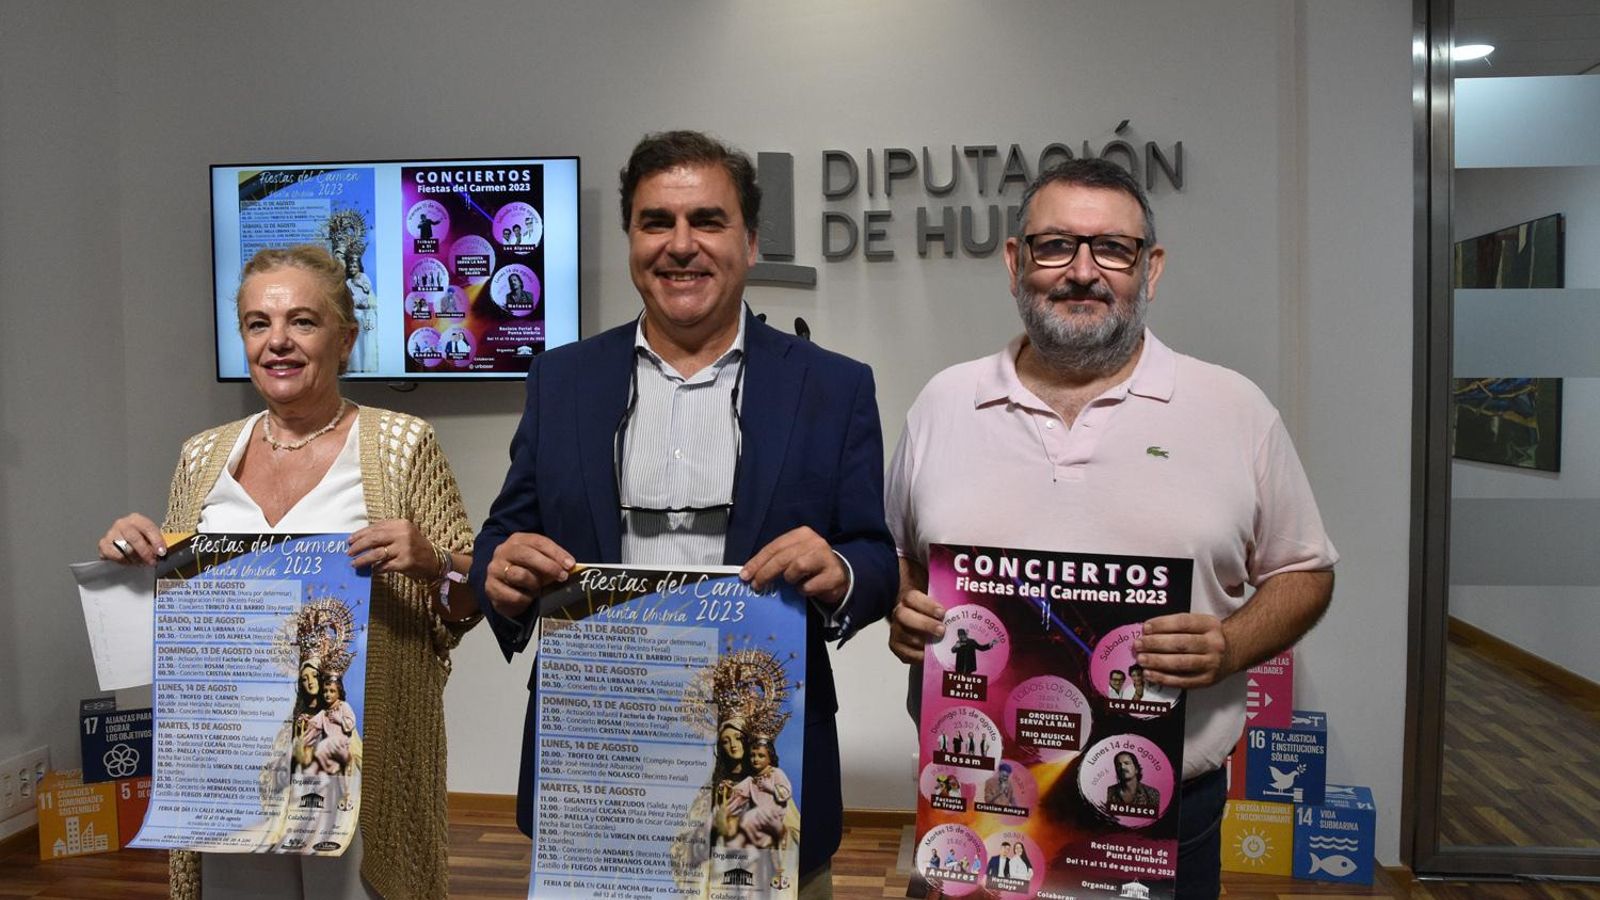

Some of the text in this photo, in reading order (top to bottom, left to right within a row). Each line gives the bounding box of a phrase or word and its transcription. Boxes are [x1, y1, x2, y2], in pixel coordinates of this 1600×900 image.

[260, 171, 294, 184] Fiestas
[298, 170, 314, 185] del
[416, 170, 531, 183] CONCIERTOS
[318, 183, 344, 195] 2023
[418, 185, 450, 193] Fiestas
[470, 184, 506, 192] Carmen
[508, 183, 531, 192] 2023
[822, 210, 895, 261] DE
[190, 534, 349, 556] Fiestas del Carmen
[204, 556, 322, 578] Punta Umbría 2023
[953, 553, 1169, 588] CONCIERTOS
[580, 568, 648, 593] Fiestas
[656, 573, 685, 597] del
[955, 576, 1168, 605] Fiestas del Carmen 2023
[597, 599, 746, 623] Punta Umbría 2023
[584, 624, 592, 633] 11
[596, 624, 608, 634] DE
[610, 625, 648, 636] AGOSTO
[962, 610, 969, 619] 11
[972, 610, 982, 620] de
[985, 618, 1006, 644] agosto
[1131, 630, 1142, 640] 12
[158, 646, 198, 655] DOMINGO,
[542, 660, 648, 676] SÁBADO, 12 DE AGOSTO
[1279, 658, 1290, 666] LAS
[948, 673, 982, 684] Tributo
[158, 684, 184, 692] LUNES,
[950, 690, 979, 699] Barrio
[542, 697, 657, 712] DOMINGO, 13 DE AGOSTO
[1109, 701, 1168, 714] Los Alpresa
[1028, 712, 1069, 721] ORQUESTA
[84, 712, 152, 734] 17 ALIANZAS PARA
[106, 725, 130, 733] LOGRAR
[158, 722, 190, 730] MARTES,
[201, 722, 211, 730] DE
[212, 723, 242, 731] AGOSTO
[597, 719, 622, 727] ROSAM
[968, 710, 978, 719] de
[979, 717, 996, 741] agosto
[1020, 718, 1044, 726] SERVA
[1057, 720, 1075, 728] BARI
[106, 730, 152, 742] LOS OBJETIVOS
[1041, 732, 1075, 742] MUSICAL
[1250, 730, 1265, 749] 16
[1286, 734, 1316, 744] JUSTICIA
[541, 738, 639, 753] LUNES, 14 DE AGOSTO
[1033, 738, 1062, 747] SALERO
[1276, 744, 1324, 754] INSTITUCIONES
[568, 752, 641, 763] TROFEO DEL CARMEN
[944, 754, 981, 766] Rosam
[1088, 740, 1162, 772] Lunes 14 de agosto
[1271, 752, 1299, 762] SÓLIDAS
[607, 770, 640, 779] NOLASCO
[122, 783, 131, 800] 5
[540, 782, 646, 797] MARTES, 15 DE AGOSTO
[38, 792, 52, 810] 11
[941, 802, 964, 811] Trapos
[976, 804, 1026, 816] Cristian Amaya
[1110, 804, 1155, 816] Nolasco
[1297, 807, 1336, 826] 14 VIDA
[1320, 820, 1359, 832] SUBMARINA
[925, 829, 945, 846] Martes
[955, 826, 964, 835] de
[602, 849, 634, 857] ANDARES
[1090, 841, 1168, 858] Recinto Ferial de
[1106, 851, 1168, 865] Punta Umbría
[1066, 857, 1078, 865] Del
[1109, 862, 1118, 870] de
[1120, 864, 1145, 874] agosto
[1147, 866, 1156, 874] de
[928, 869, 976, 881] Andares
[992, 877, 1024, 886] Hermanos
[1081, 880, 1117, 891] Organiza:
